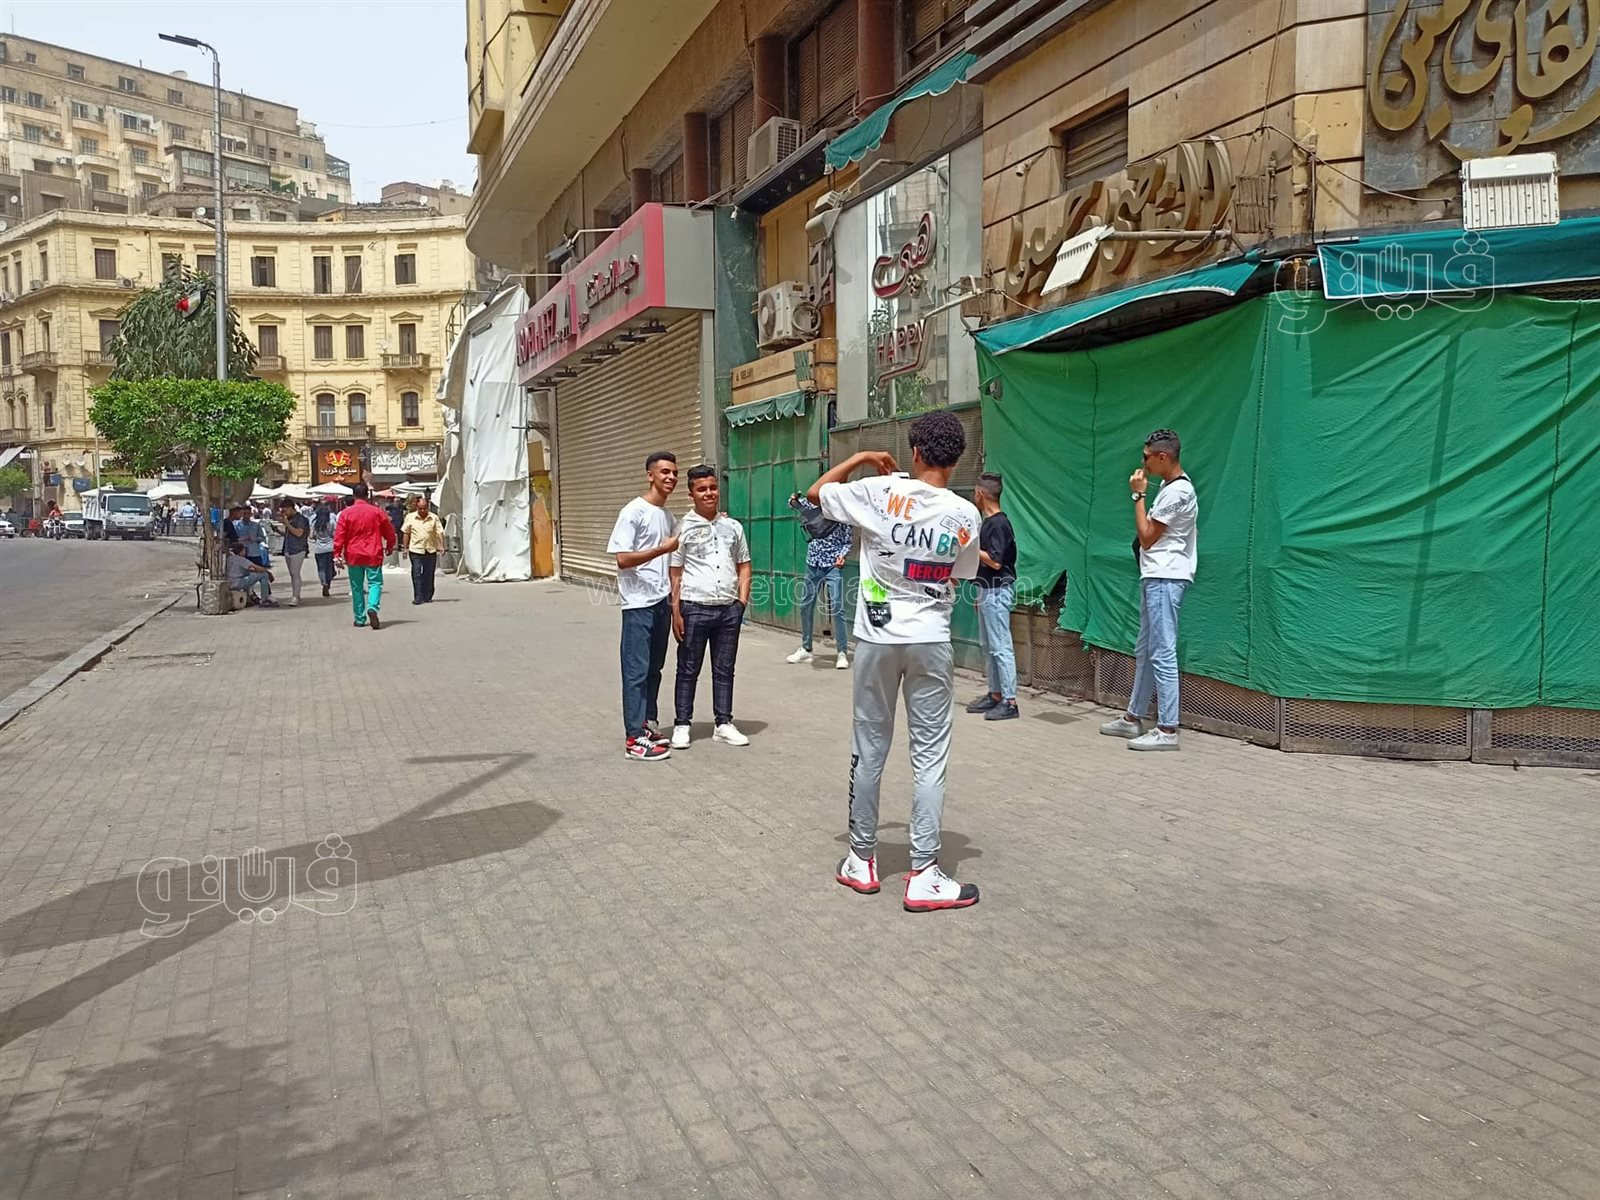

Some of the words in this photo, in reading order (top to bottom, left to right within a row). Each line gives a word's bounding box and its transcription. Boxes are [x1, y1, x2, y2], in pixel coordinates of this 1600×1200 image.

[876, 319, 934, 368] HAPPY
[887, 492, 917, 520] WE
[891, 523, 934, 550] CAN
[936, 533, 959, 557] BE
